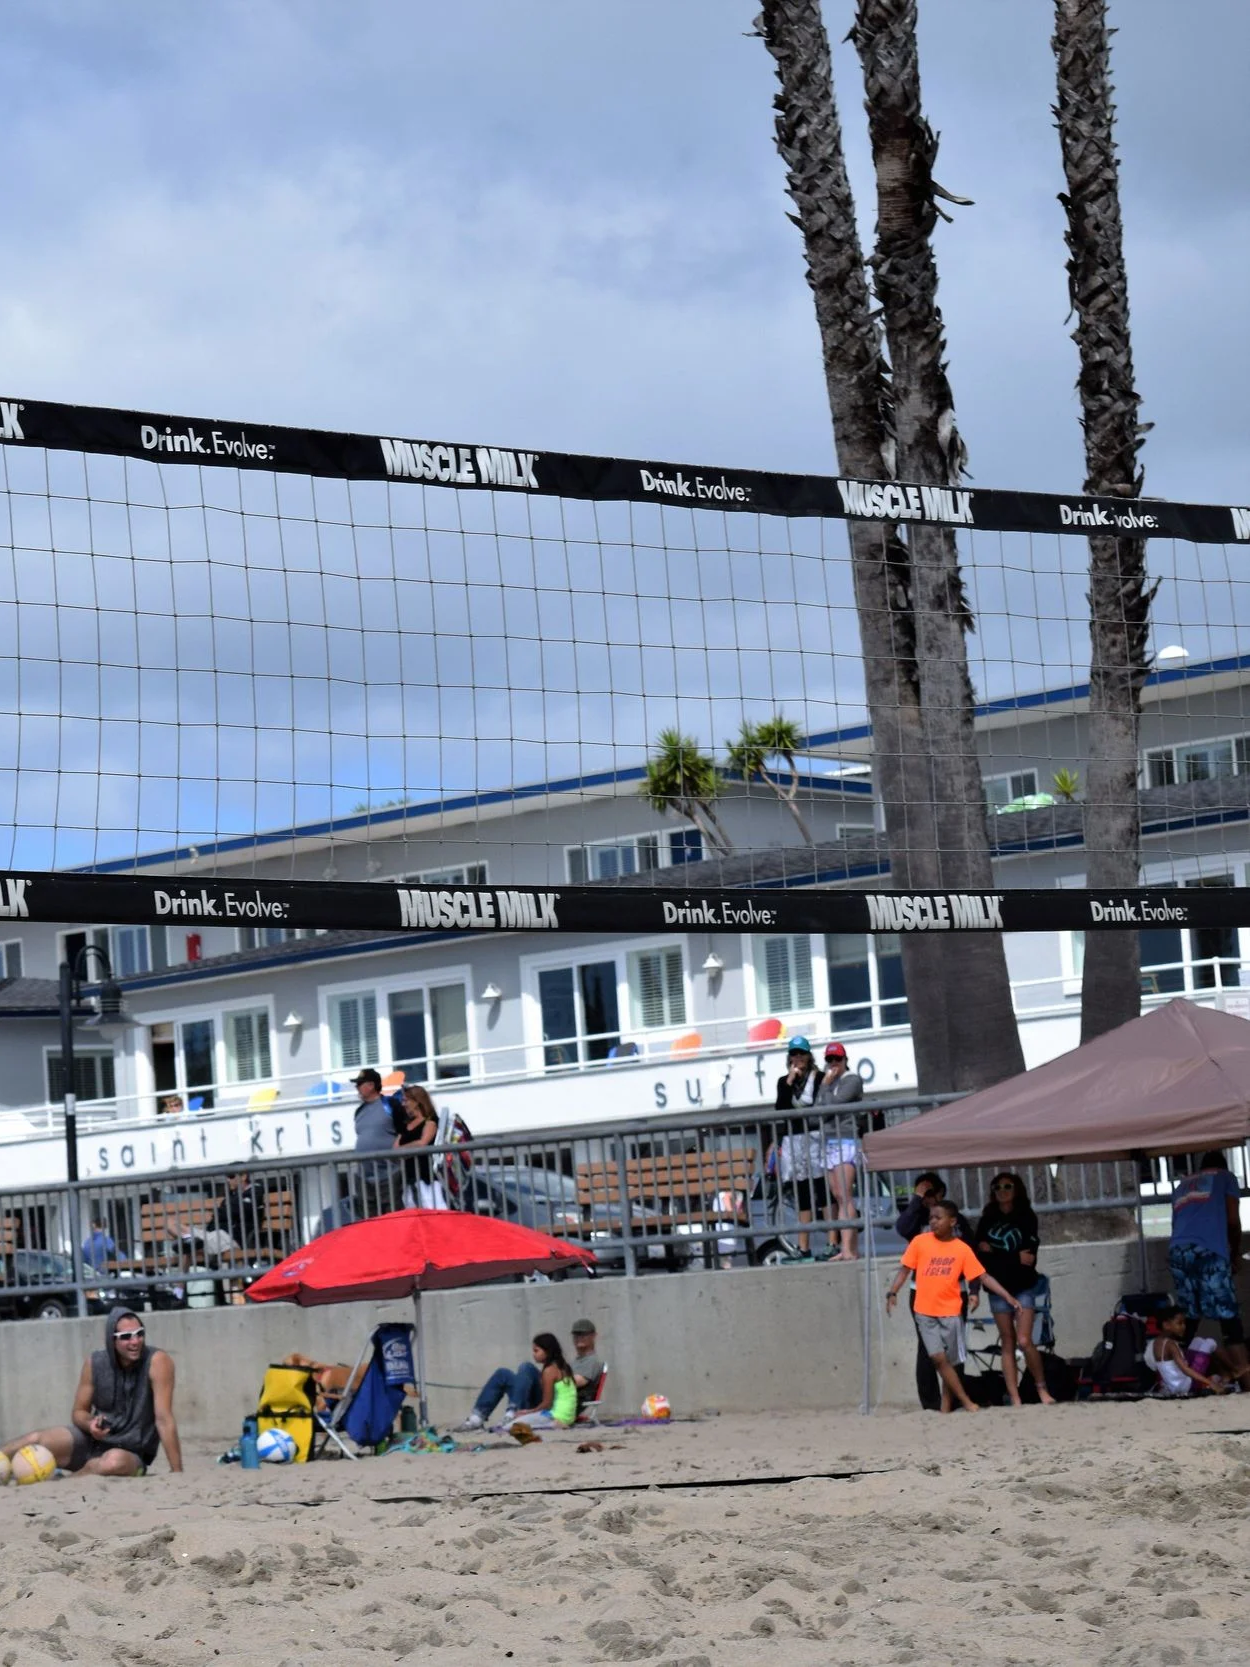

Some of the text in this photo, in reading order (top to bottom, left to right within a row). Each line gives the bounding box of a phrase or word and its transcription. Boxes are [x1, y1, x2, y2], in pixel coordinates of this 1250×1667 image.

[379, 438, 476, 483] MUSCLE
[837, 480, 922, 520] MUSCLE
[397, 889, 496, 929] MUSCLE
[865, 894, 950, 931] MUSCLE
[100, 1112, 342, 1171] saint kris
